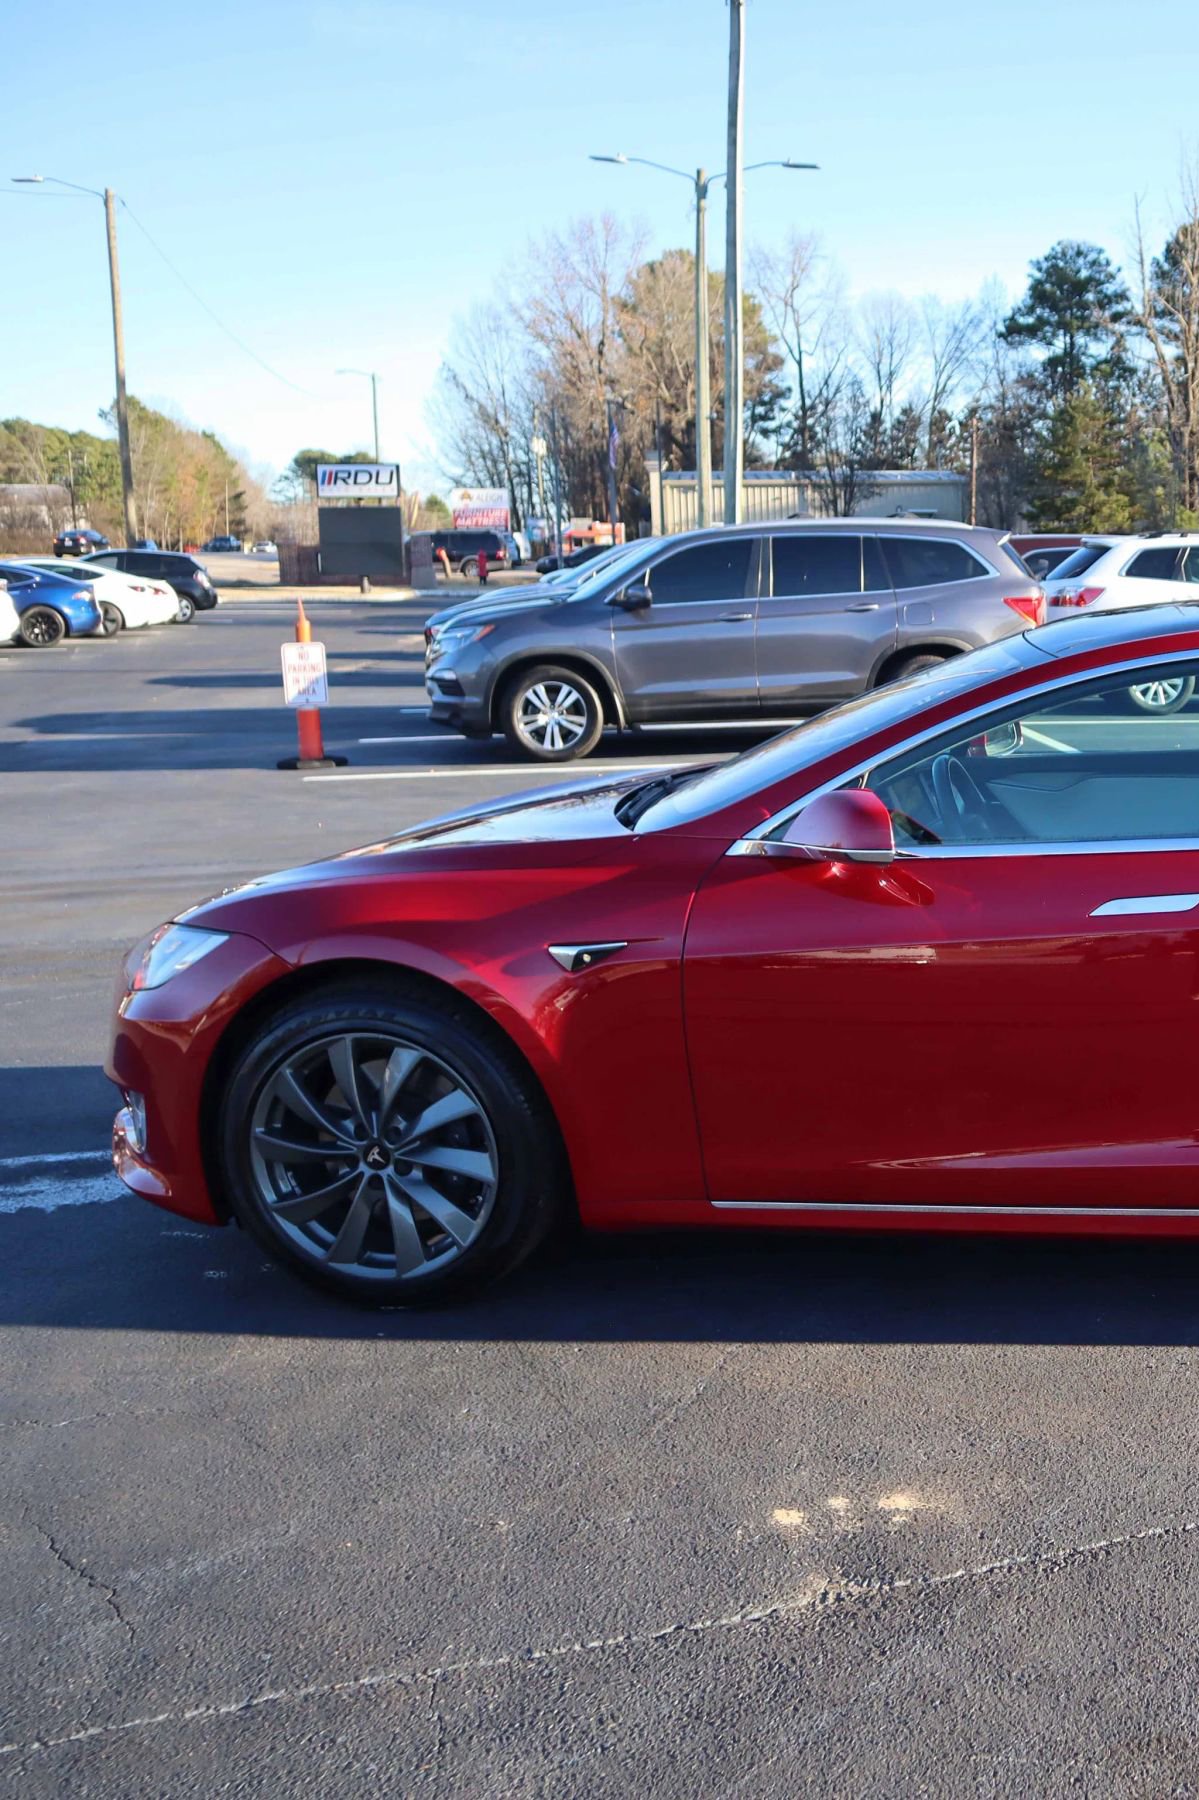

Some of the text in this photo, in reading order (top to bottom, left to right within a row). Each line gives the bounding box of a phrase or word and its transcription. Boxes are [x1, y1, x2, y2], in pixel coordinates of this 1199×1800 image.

[333, 469, 394, 486] RDU
[298, 651, 310, 661] NO
[288, 663, 322, 673] PARKING
[298, 686, 317, 696] AREA
